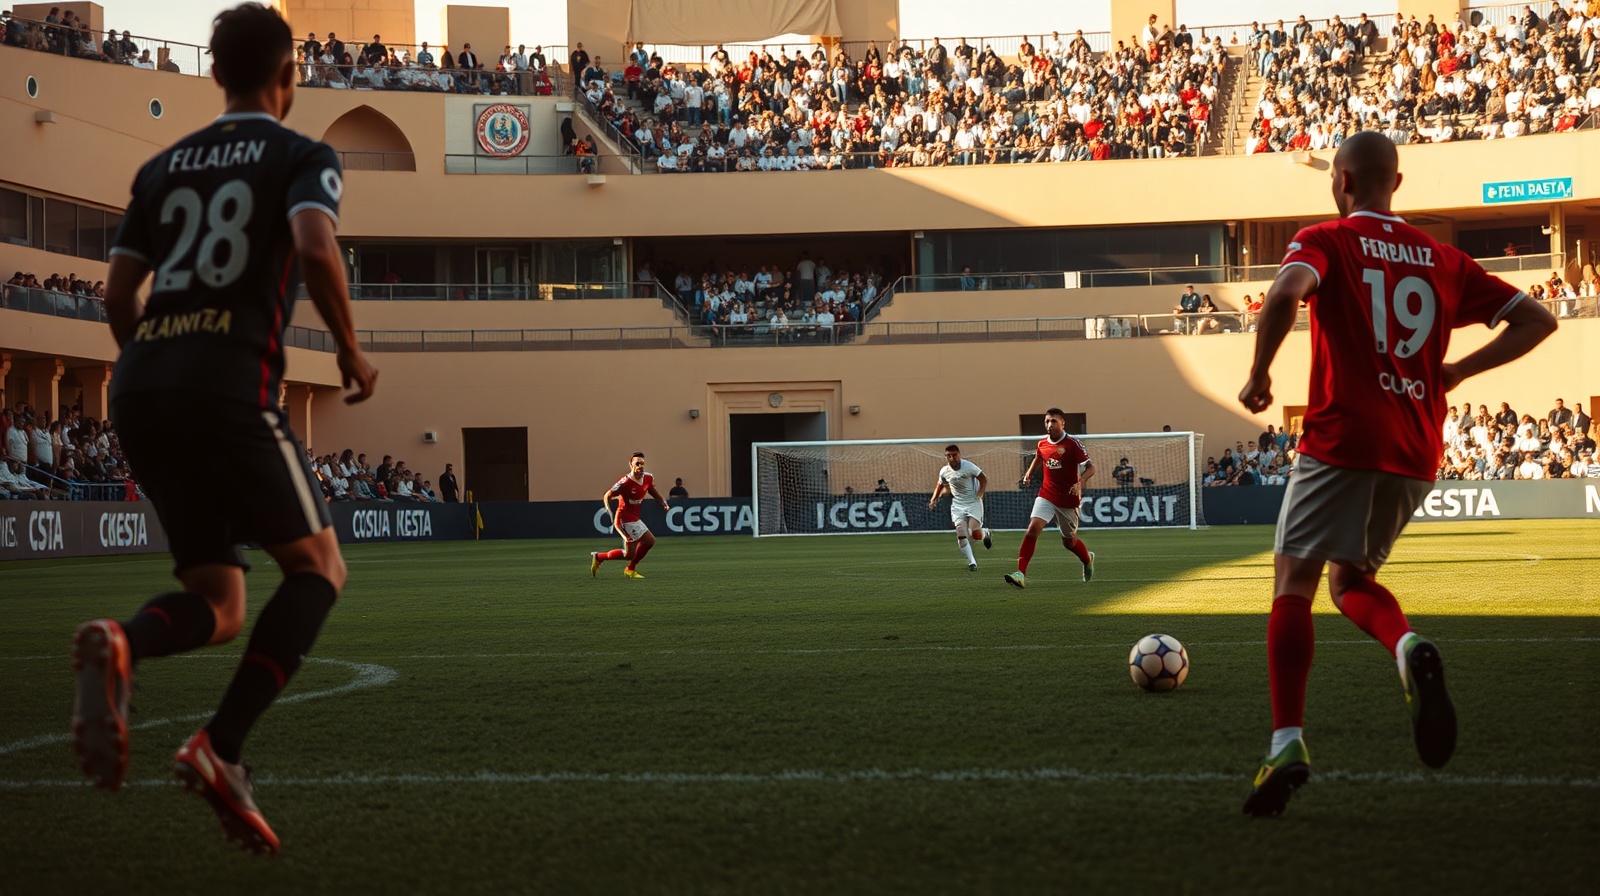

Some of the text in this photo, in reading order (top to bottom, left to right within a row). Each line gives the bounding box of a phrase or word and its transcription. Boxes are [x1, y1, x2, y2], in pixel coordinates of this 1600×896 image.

[154, 180, 252, 292] 28
[1362, 267, 1436, 359] 19
[665, 505, 753, 533] CESTA
[1078, 494, 1177, 523] CESAIT
[1413, 487, 1501, 518] ESTA
[28, 510, 64, 551] CSTA
